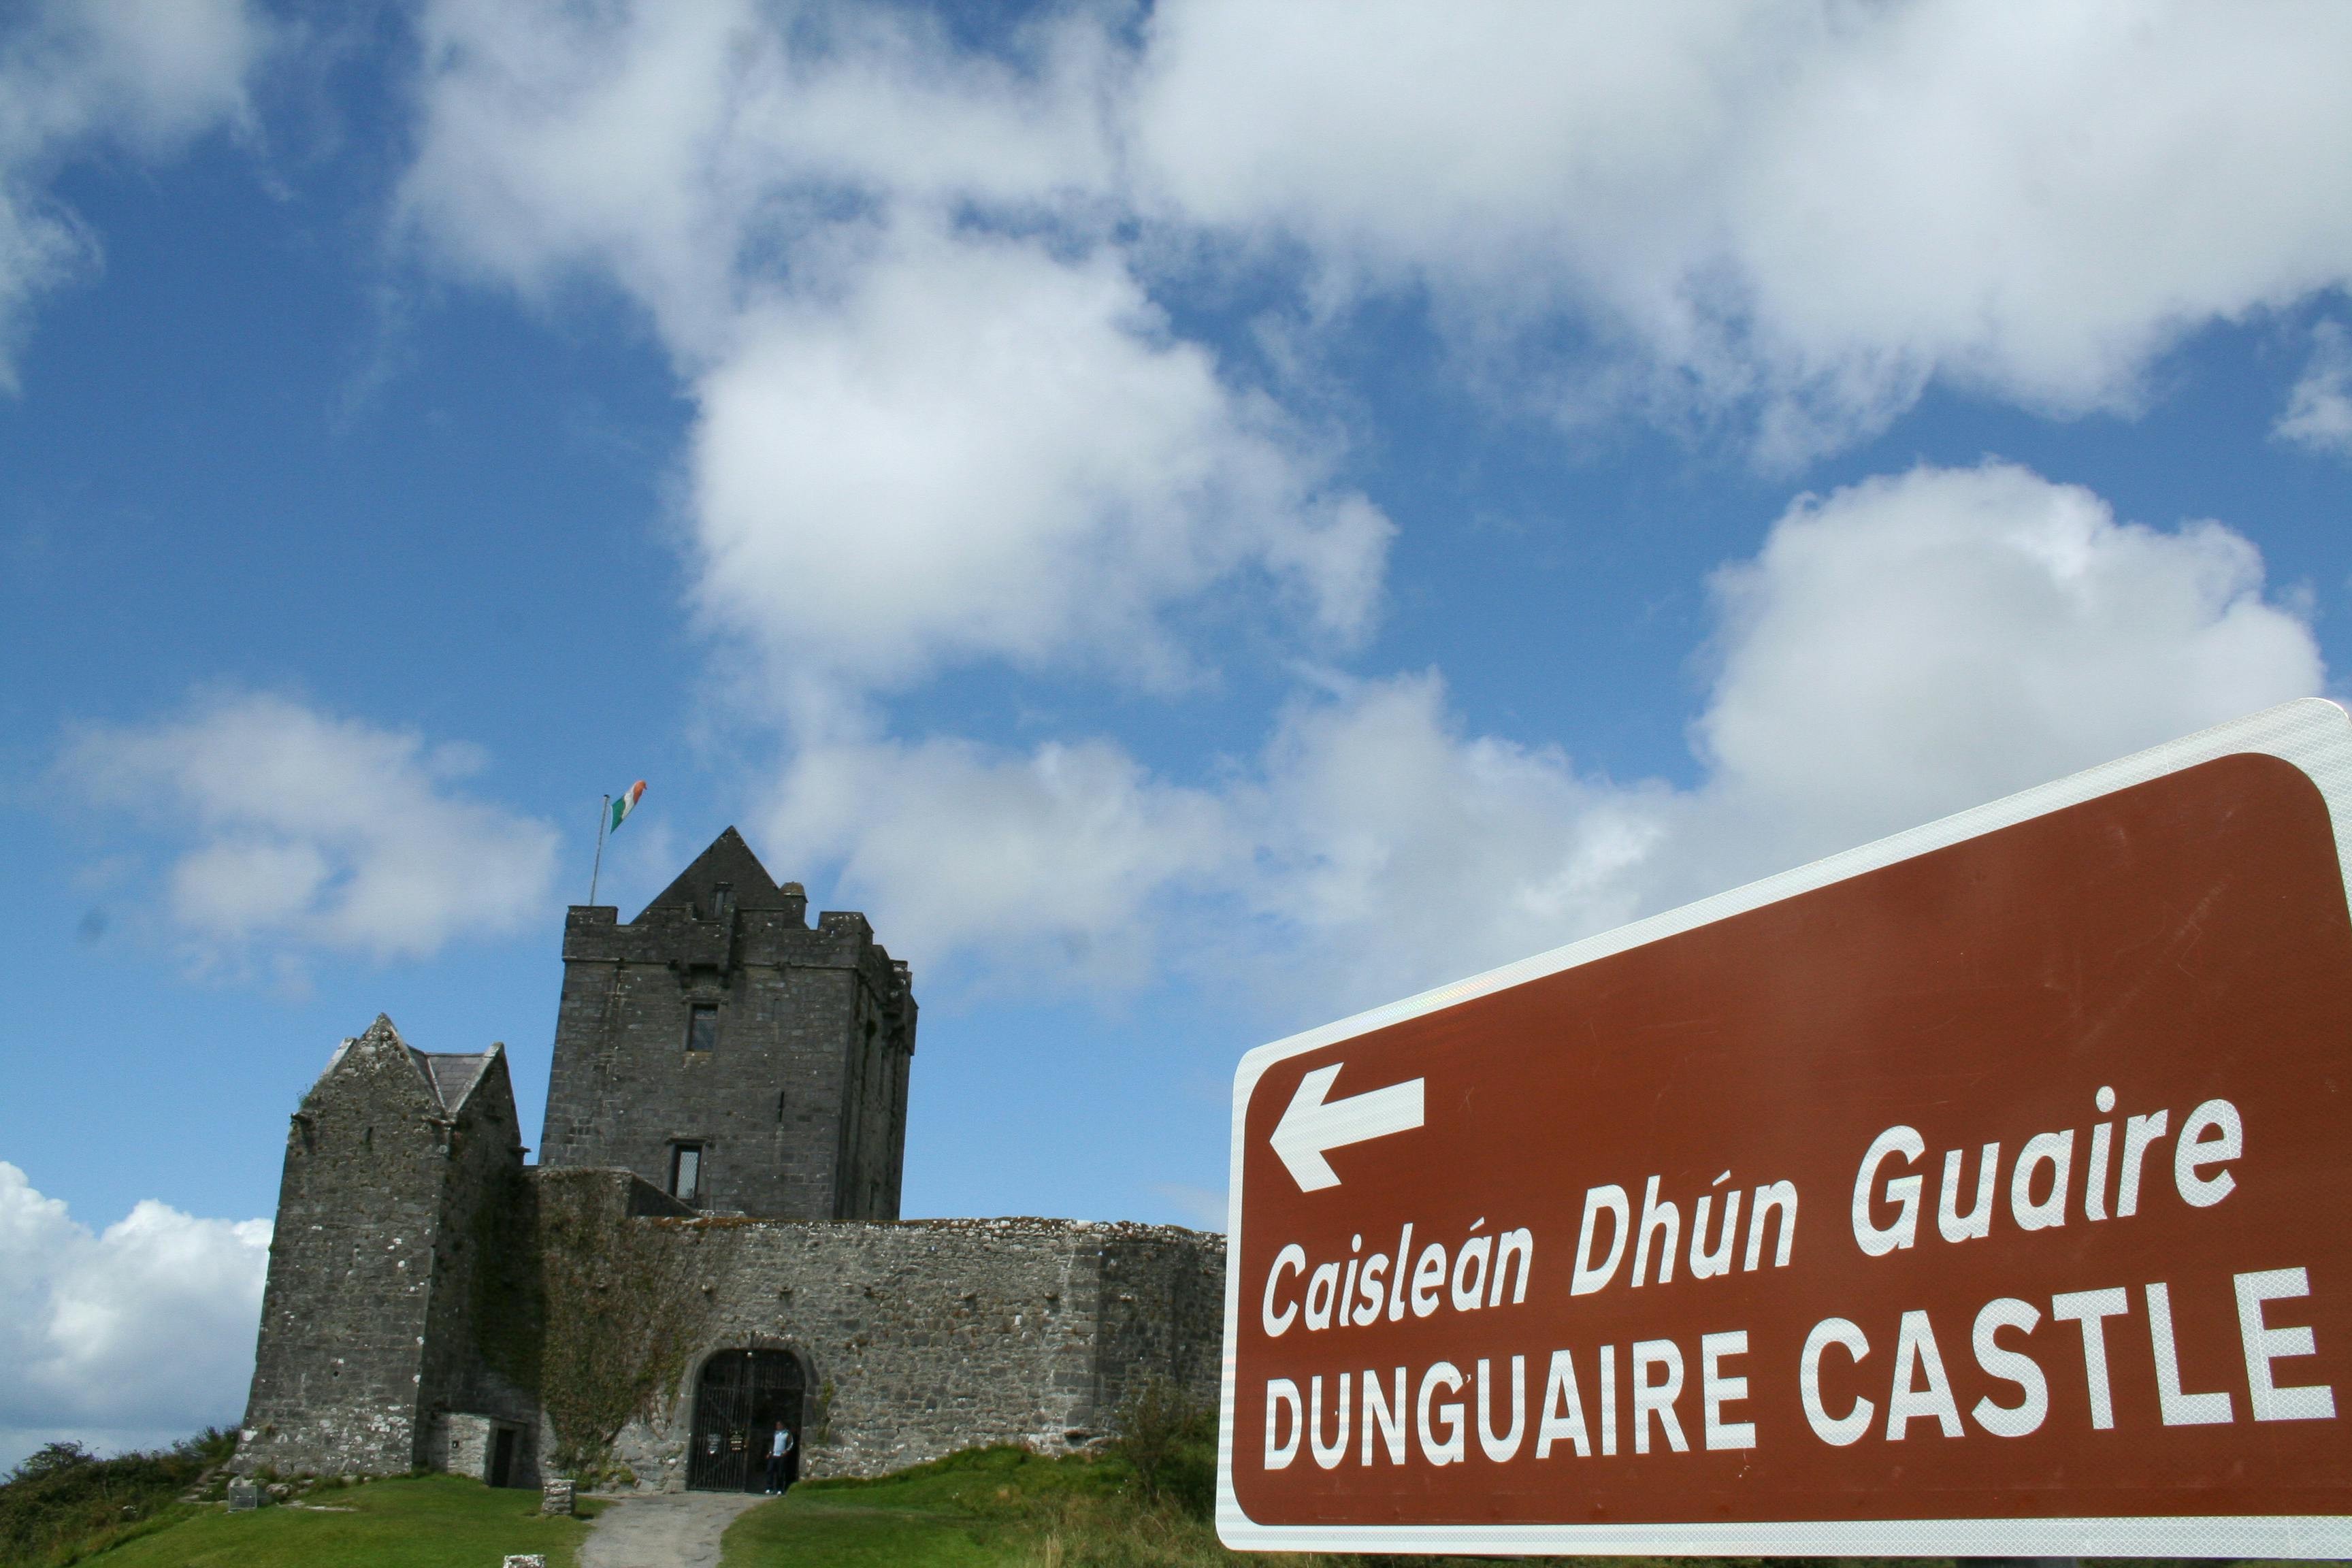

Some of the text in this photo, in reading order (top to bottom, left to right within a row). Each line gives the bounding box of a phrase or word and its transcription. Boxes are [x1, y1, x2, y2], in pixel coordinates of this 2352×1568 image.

[1262, 1086, 2243, 1337] Caisleán Dhún Guaire
[1264, 1267, 2336, 1470] DUNGUAIRE CASTLE
